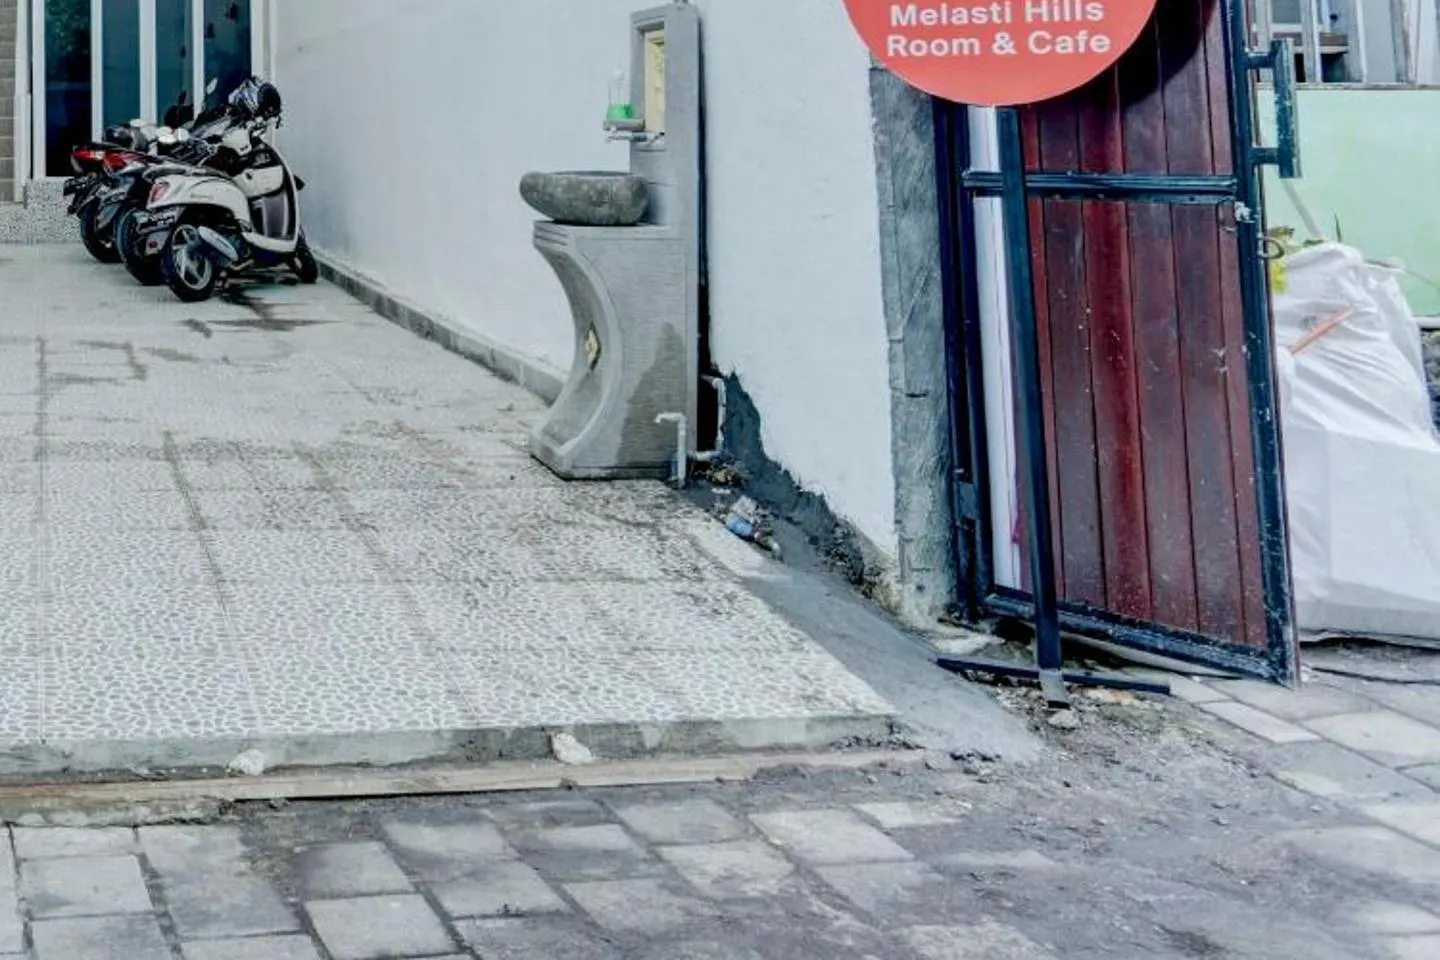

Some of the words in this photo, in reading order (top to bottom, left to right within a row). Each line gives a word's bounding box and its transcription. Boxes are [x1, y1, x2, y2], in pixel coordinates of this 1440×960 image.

[890, 0, 1013, 27] Melasti
[887, 34, 981, 58] Room
[992, 31, 1017, 55] &
[1028, 30, 1111, 54] Cafe
